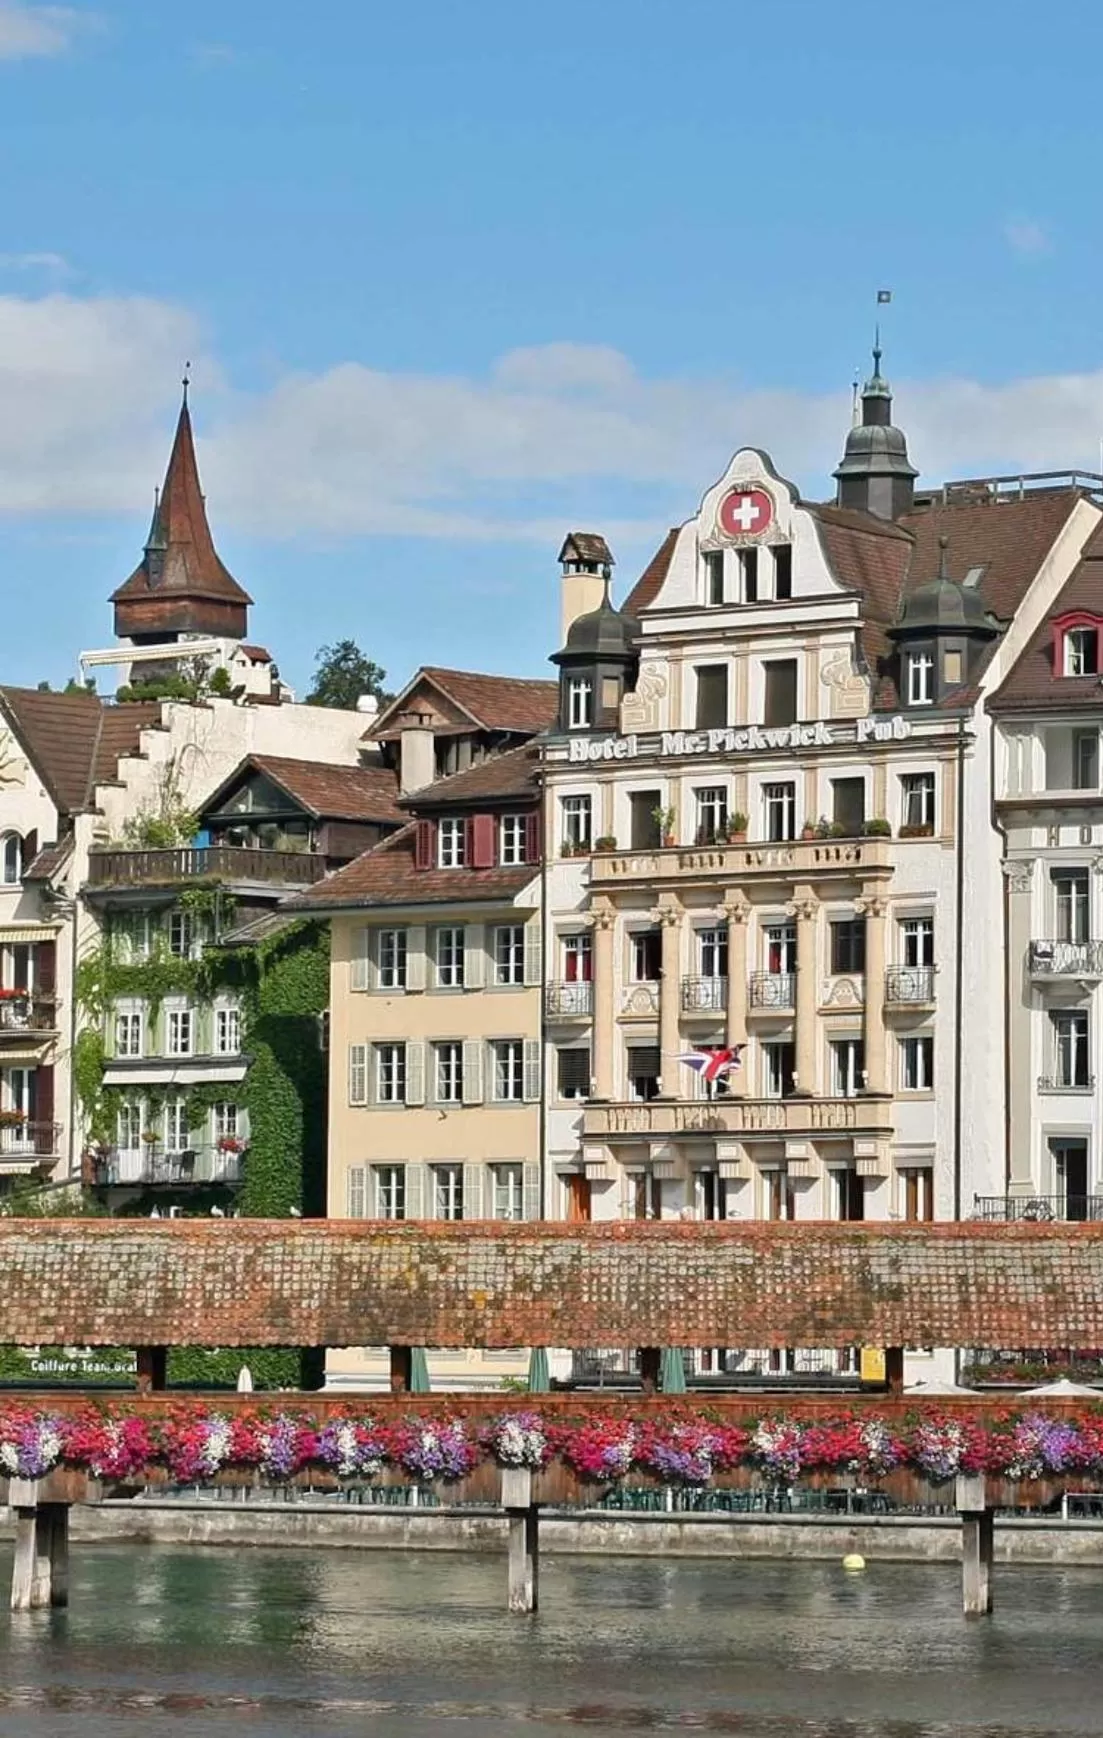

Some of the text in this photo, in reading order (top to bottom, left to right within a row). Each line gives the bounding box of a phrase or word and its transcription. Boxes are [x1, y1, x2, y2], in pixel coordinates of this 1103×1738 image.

[568, 734, 638, 763] Hotel
[707, 721, 836, 753] Pickwick
[856, 715, 912, 743] Pub
